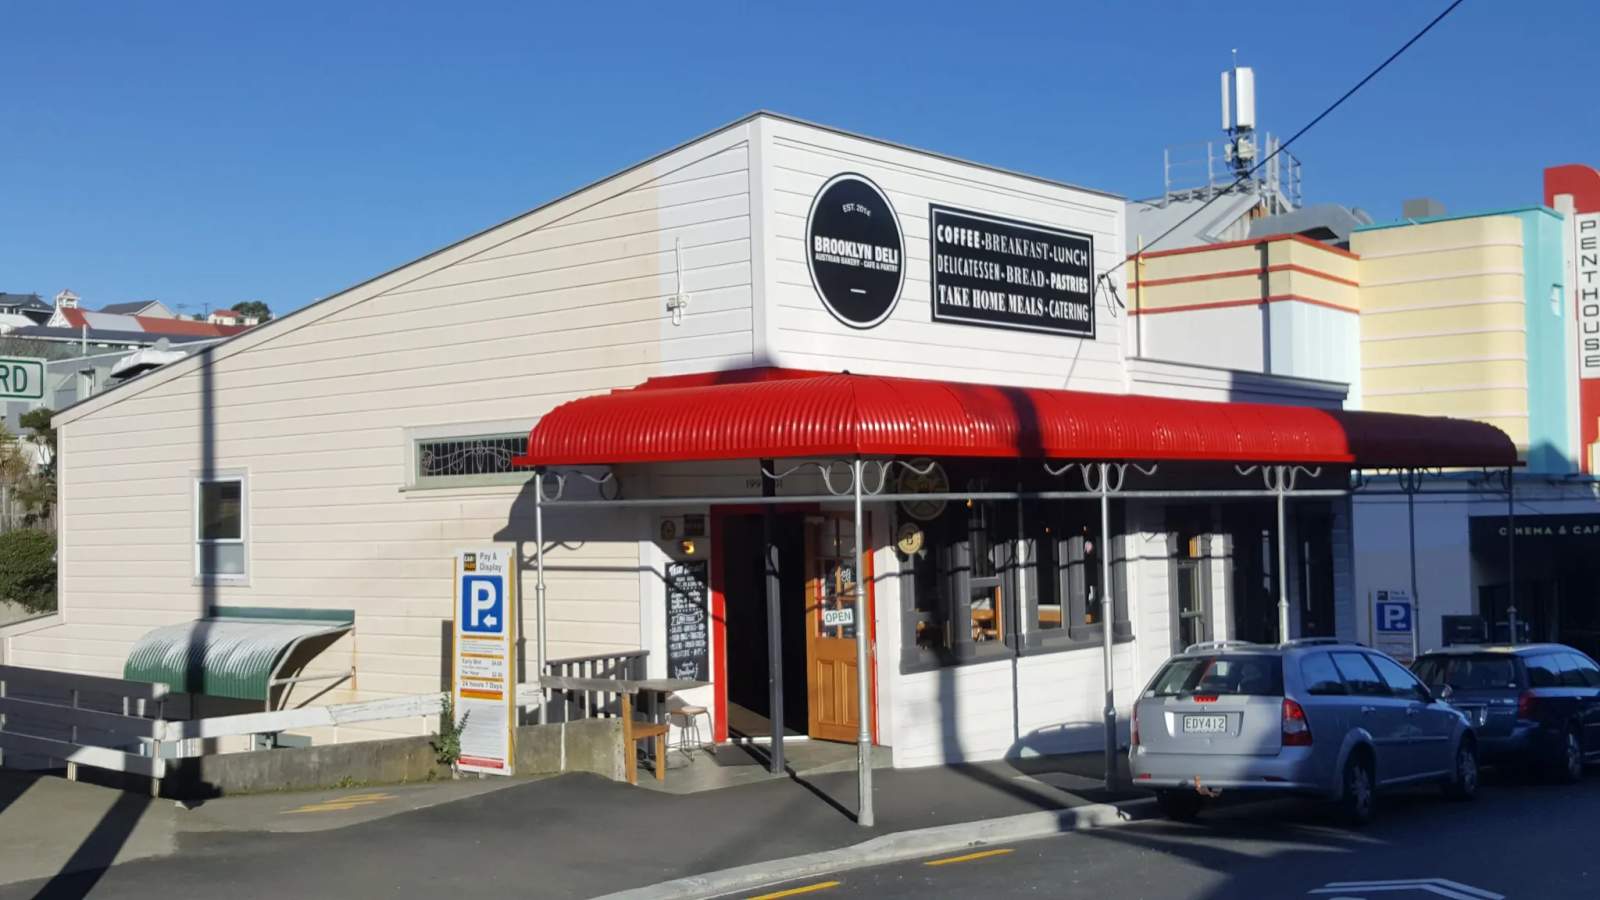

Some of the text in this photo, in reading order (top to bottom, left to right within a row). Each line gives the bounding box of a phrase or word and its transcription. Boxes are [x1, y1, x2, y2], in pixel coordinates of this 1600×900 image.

[814, 235, 898, 265] BROOKLYN DELI
[937, 225, 1088, 267] COFFEE BREAKFAST LUNCH
[937, 254, 1088, 294] DELICATESSEN BREAD PASTRIES
[938, 285, 1089, 322] TAKE HOME MEALS CATERING
[1580, 220, 1600, 367] PENTHOUSE
[0, 365, 27, 392] RD
[1499, 527, 1553, 536] CNEMA
[479, 552, 491, 561] Pay
[479, 562, 502, 573] Display
[470, 580, 496, 626] P
[825, 612, 851, 622] OPEN
[1384, 605, 1405, 629] P
[1185, 718, 1225, 729] EDY412
